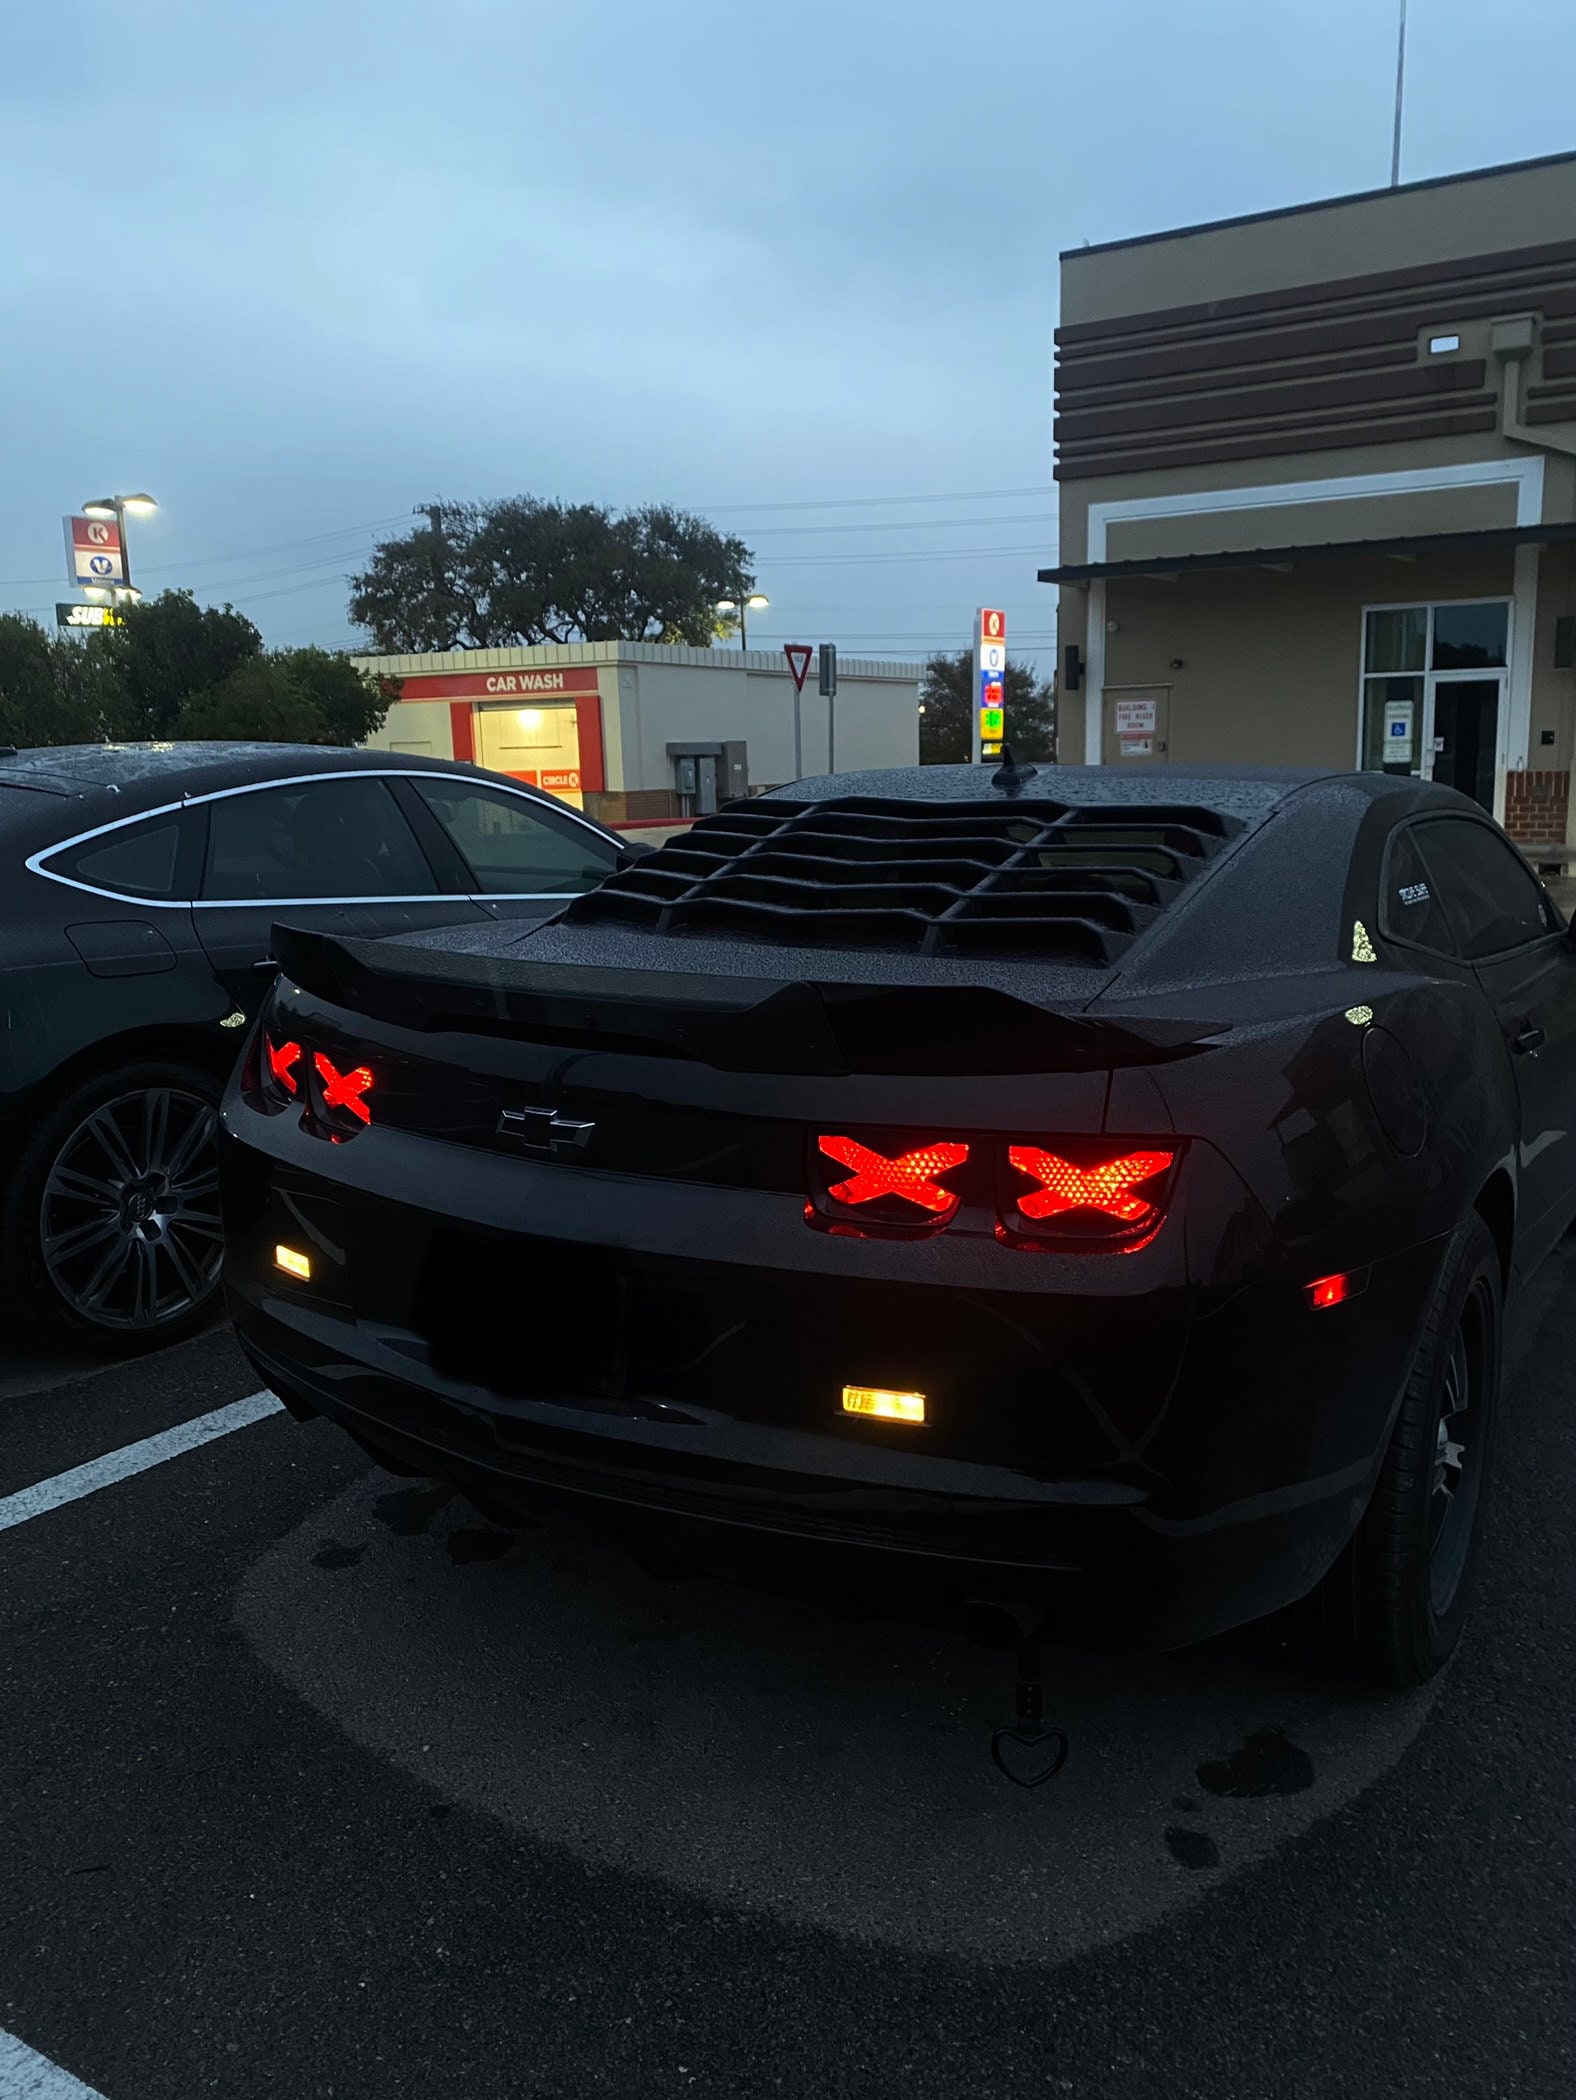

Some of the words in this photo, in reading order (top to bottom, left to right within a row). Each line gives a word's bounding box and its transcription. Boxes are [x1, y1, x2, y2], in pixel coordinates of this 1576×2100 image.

[90, 523, 108, 544] K
[486, 676, 516, 692] CAR
[519, 673, 564, 691] WASH
[542, 775, 568, 786] CIRCLE
[569, 772, 579, 788] K
